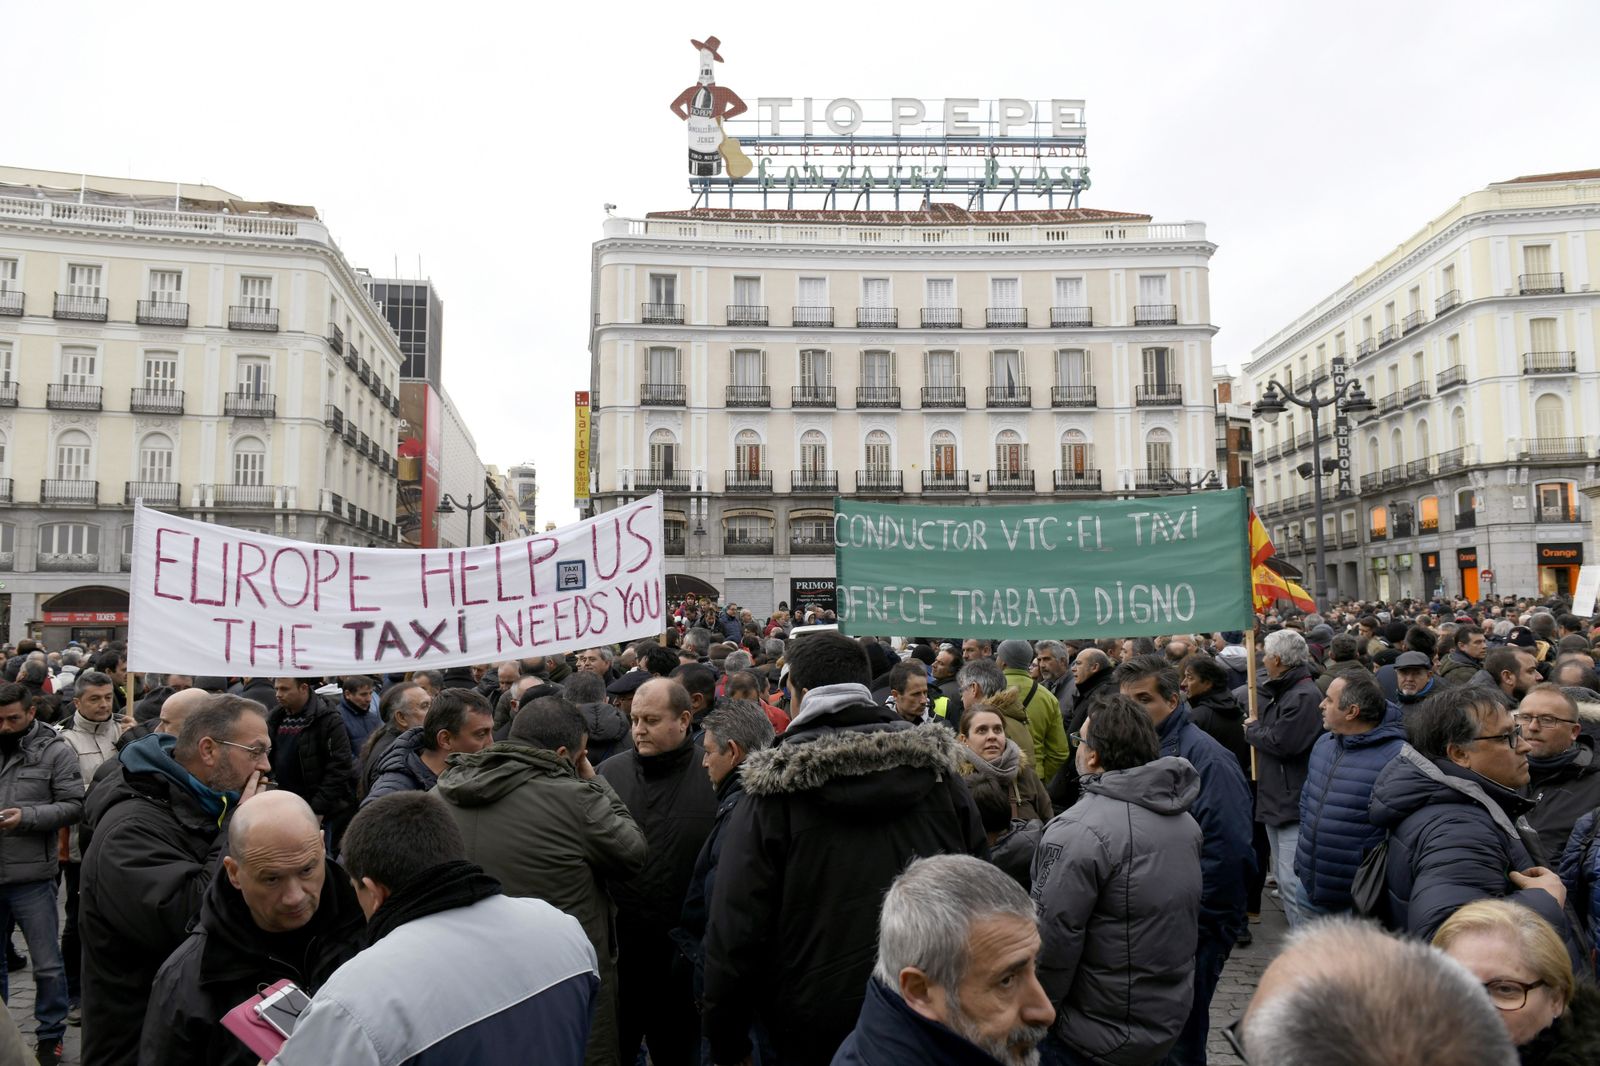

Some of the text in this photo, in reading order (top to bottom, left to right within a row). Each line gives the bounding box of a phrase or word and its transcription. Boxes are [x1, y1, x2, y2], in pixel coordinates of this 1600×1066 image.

[758, 97, 1087, 137] TIO PEPE
[754, 144, 1087, 157] SOL DE ANDALUCIA EMBOTELLADO
[759, 157, 1092, 190] GONZALEZ BYASS
[1337, 425, 1351, 491] EUROPA
[834, 512, 988, 551] CONDUCTOR
[154, 505, 653, 611] EUROPE HELP US
[1542, 549, 1577, 558] Orange
[796, 581, 834, 589] PRIMOR
[96, 613, 116, 621] TICKETS
[213, 617, 313, 670] THE
[496, 591, 609, 653] NEEDS
[615, 578, 662, 628] YOU
[836, 585, 937, 625] OFRECE
[950, 587, 1080, 627] TRABAJO
